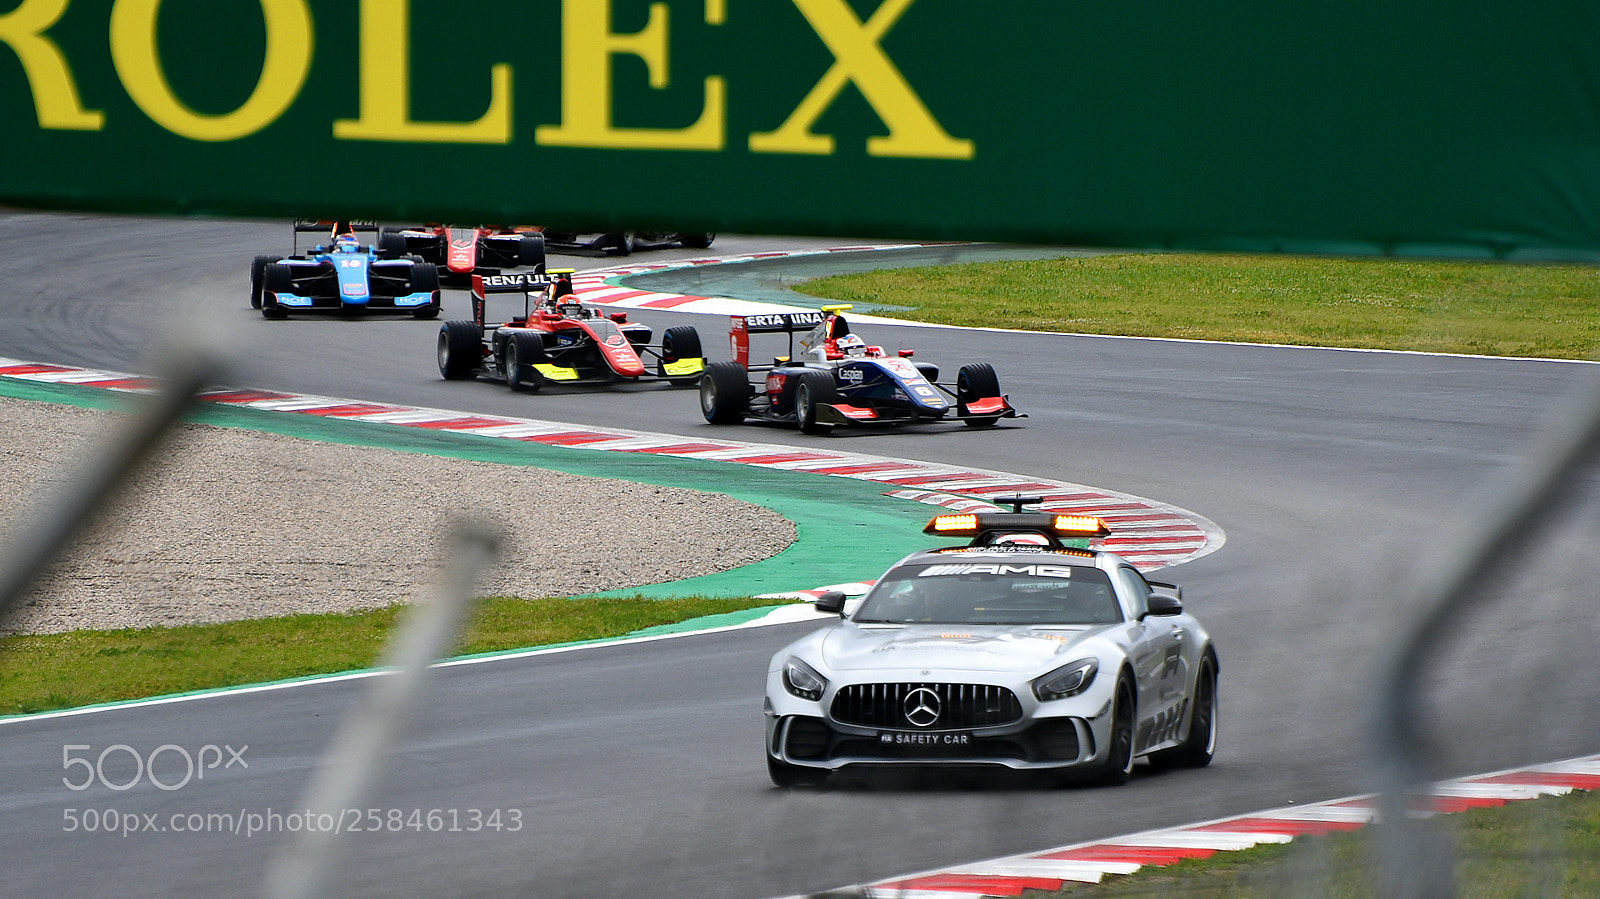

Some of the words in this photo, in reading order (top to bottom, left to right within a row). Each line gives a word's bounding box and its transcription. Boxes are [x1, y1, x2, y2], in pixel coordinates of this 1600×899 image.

[838, 366, 864, 386] Caspian
[914, 386, 934, 396] 6
[962, 564, 1072, 578] AMG
[895, 734, 939, 744] SAFETY
[943, 734, 968, 744] CAR
